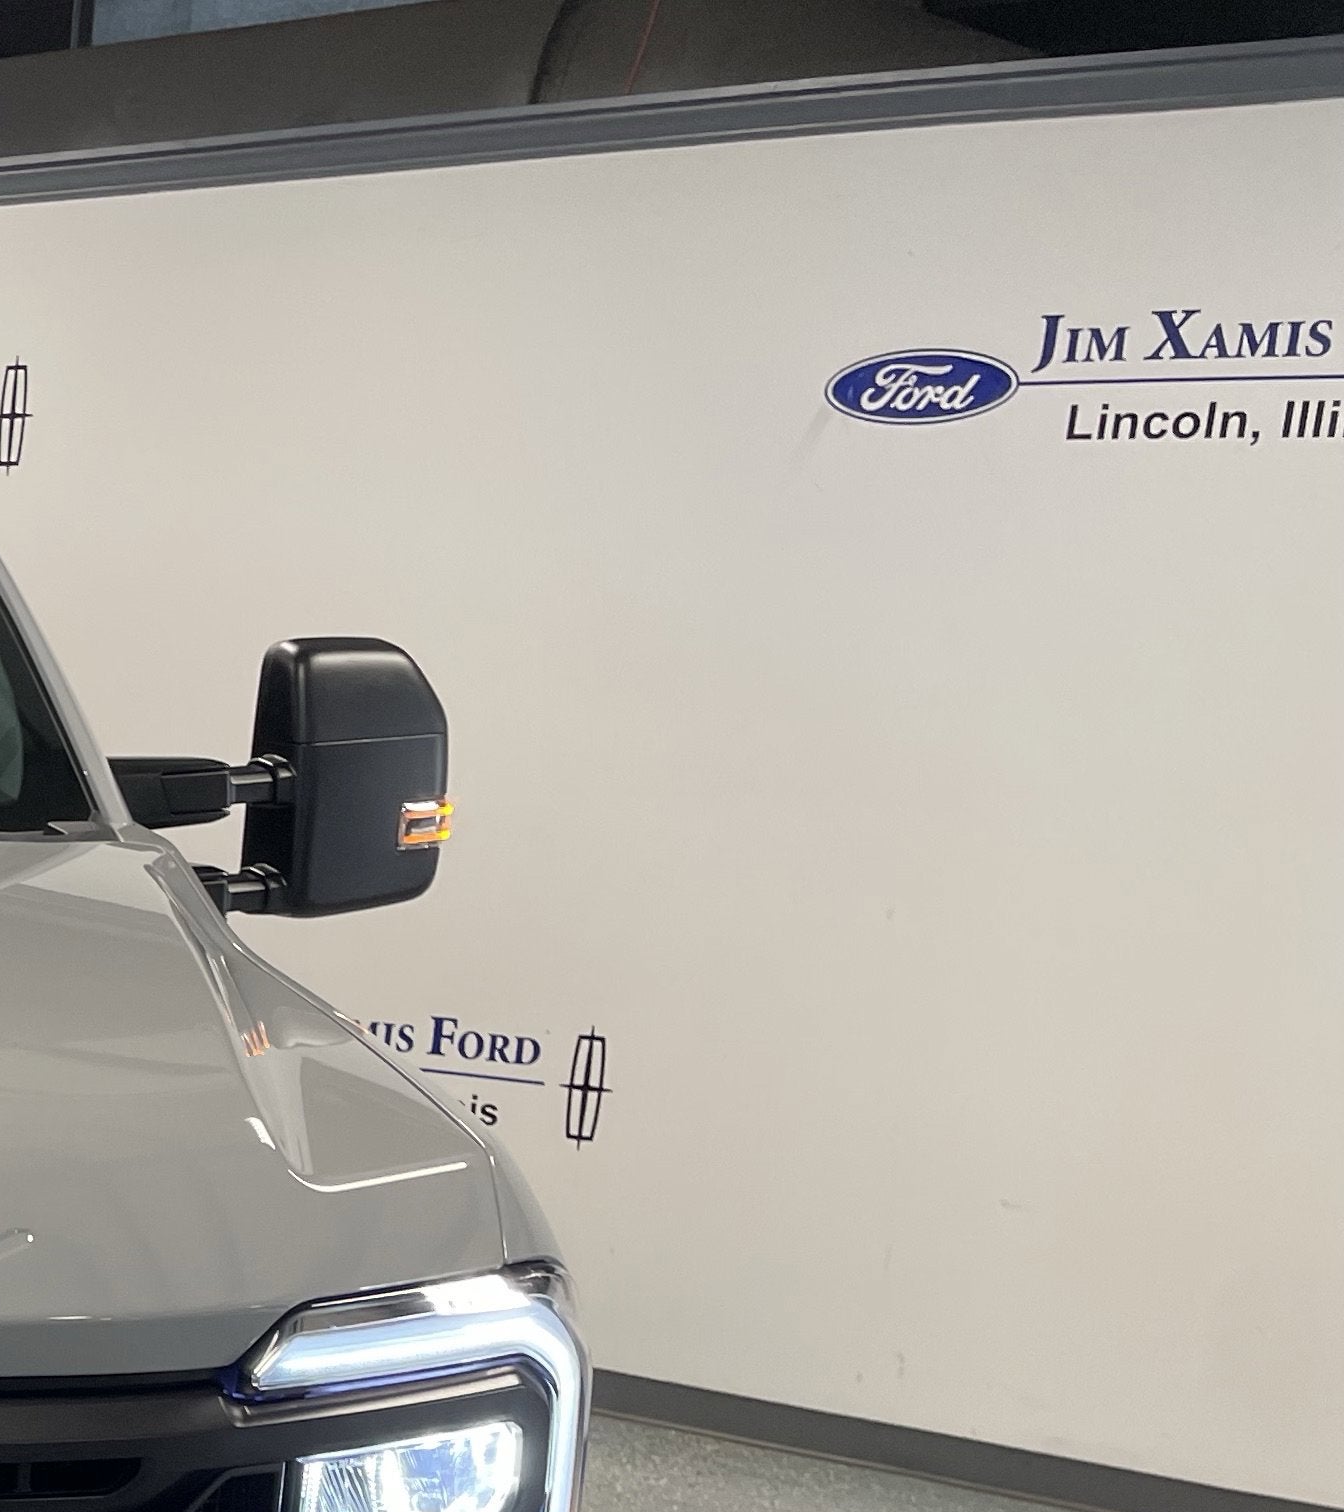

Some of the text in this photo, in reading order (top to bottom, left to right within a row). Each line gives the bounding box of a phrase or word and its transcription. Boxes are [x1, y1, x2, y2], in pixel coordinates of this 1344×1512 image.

[1030, 308, 1333, 373] JIM XAMIS
[860, 362, 980, 412] Ford
[1066, 400, 1344, 447] Lincoln, Illi
[426, 1015, 542, 1065] FORD
